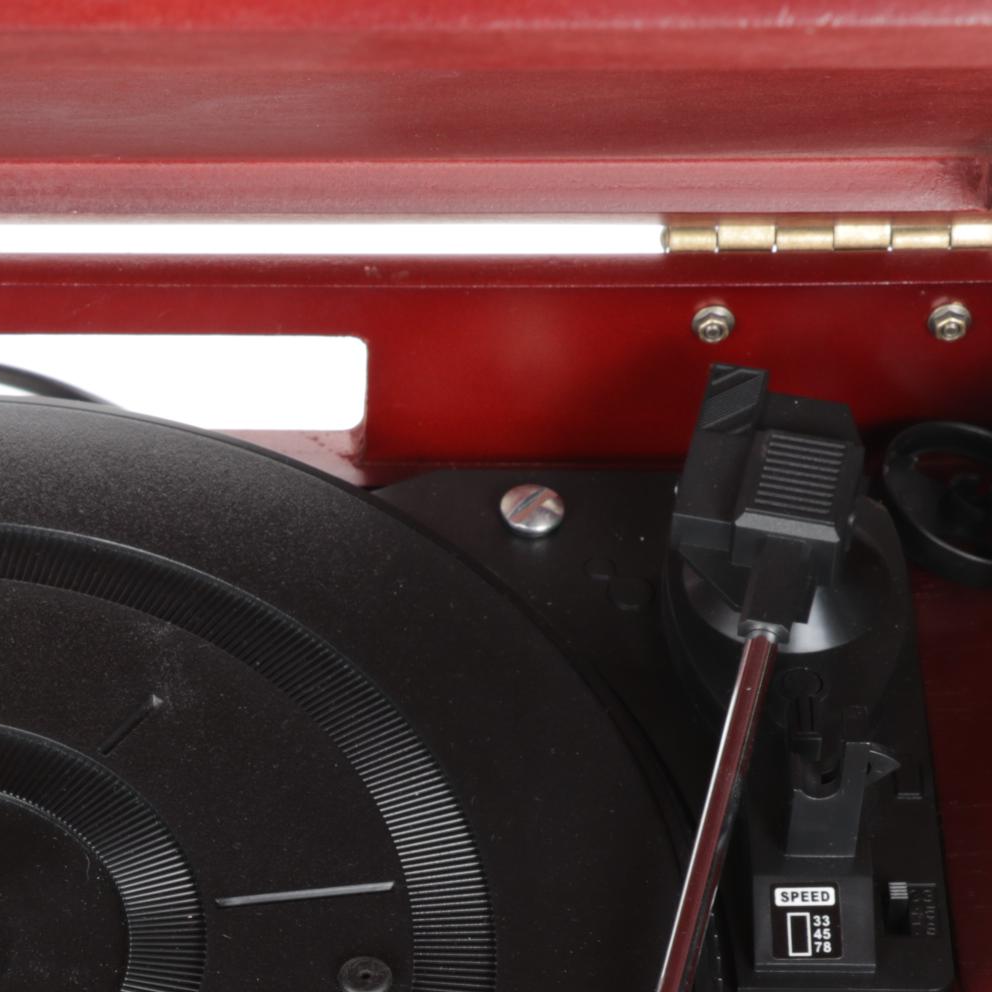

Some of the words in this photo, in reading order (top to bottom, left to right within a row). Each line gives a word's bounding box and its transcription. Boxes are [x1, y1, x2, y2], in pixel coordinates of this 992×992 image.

[781, 891, 830, 902] SPEED
[813, 915, 830, 926] 33
[814, 928, 830, 940] 45
[814, 941, 831, 953] 78
